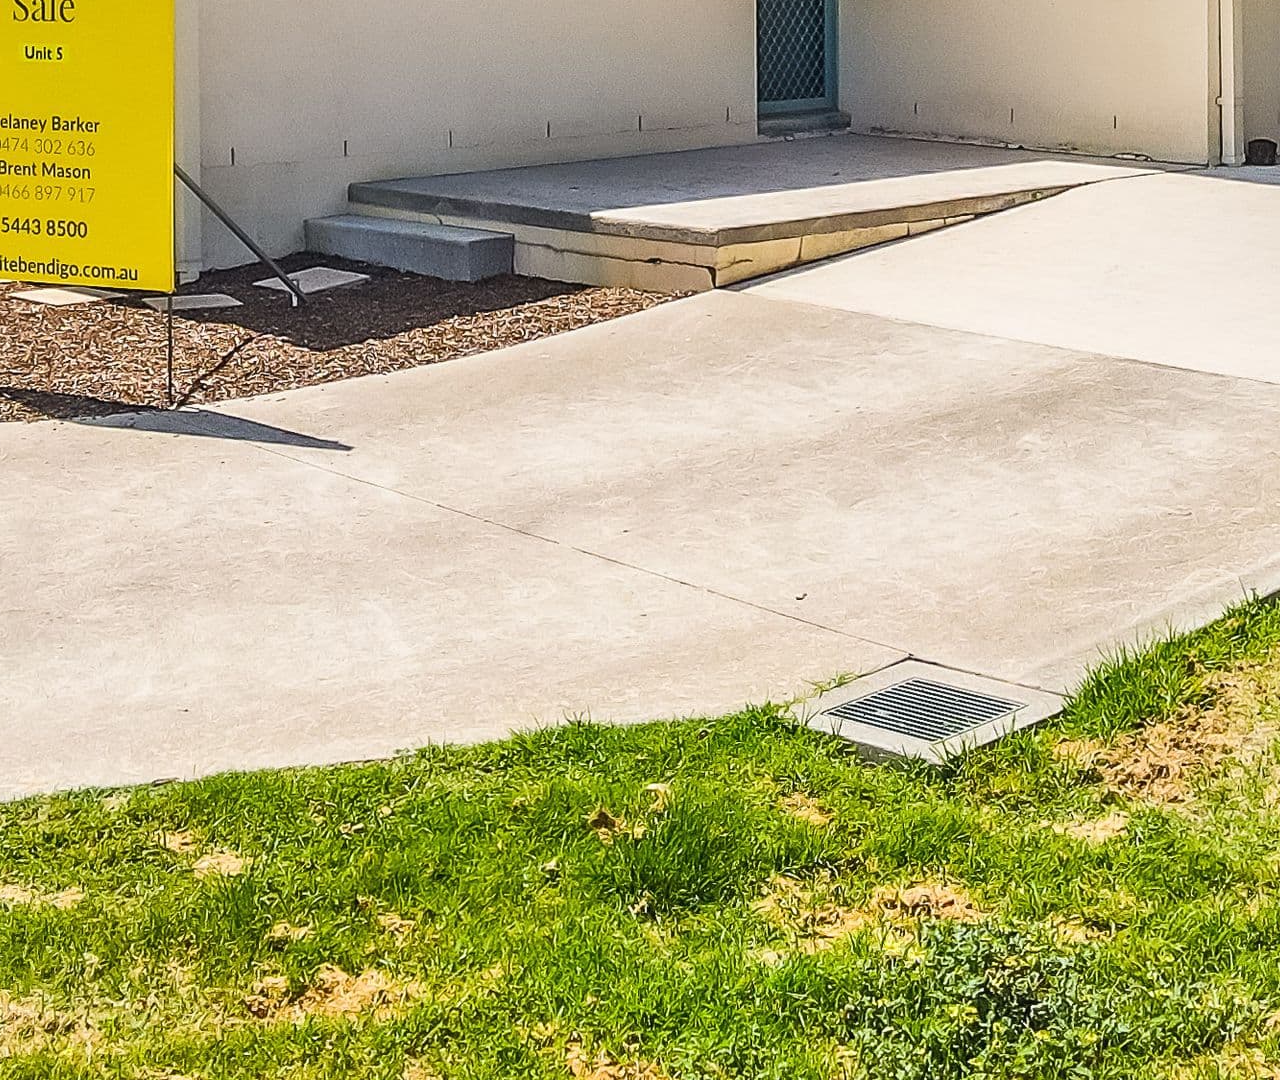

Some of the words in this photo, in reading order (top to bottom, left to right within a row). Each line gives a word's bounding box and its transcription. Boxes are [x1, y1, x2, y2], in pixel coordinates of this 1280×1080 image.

[24, 46, 53, 60] Unit
[56, 47, 63, 60] 5
[51, 116, 100, 133] Barker
[34, 139, 62, 155] 302
[67, 141, 96, 157] 636
[42, 163, 91, 180] Mason
[34, 186, 62, 201] 897
[68, 188, 96, 204] 917
[1, 217, 41, 235] 5443
[46, 219, 88, 238] 8500
